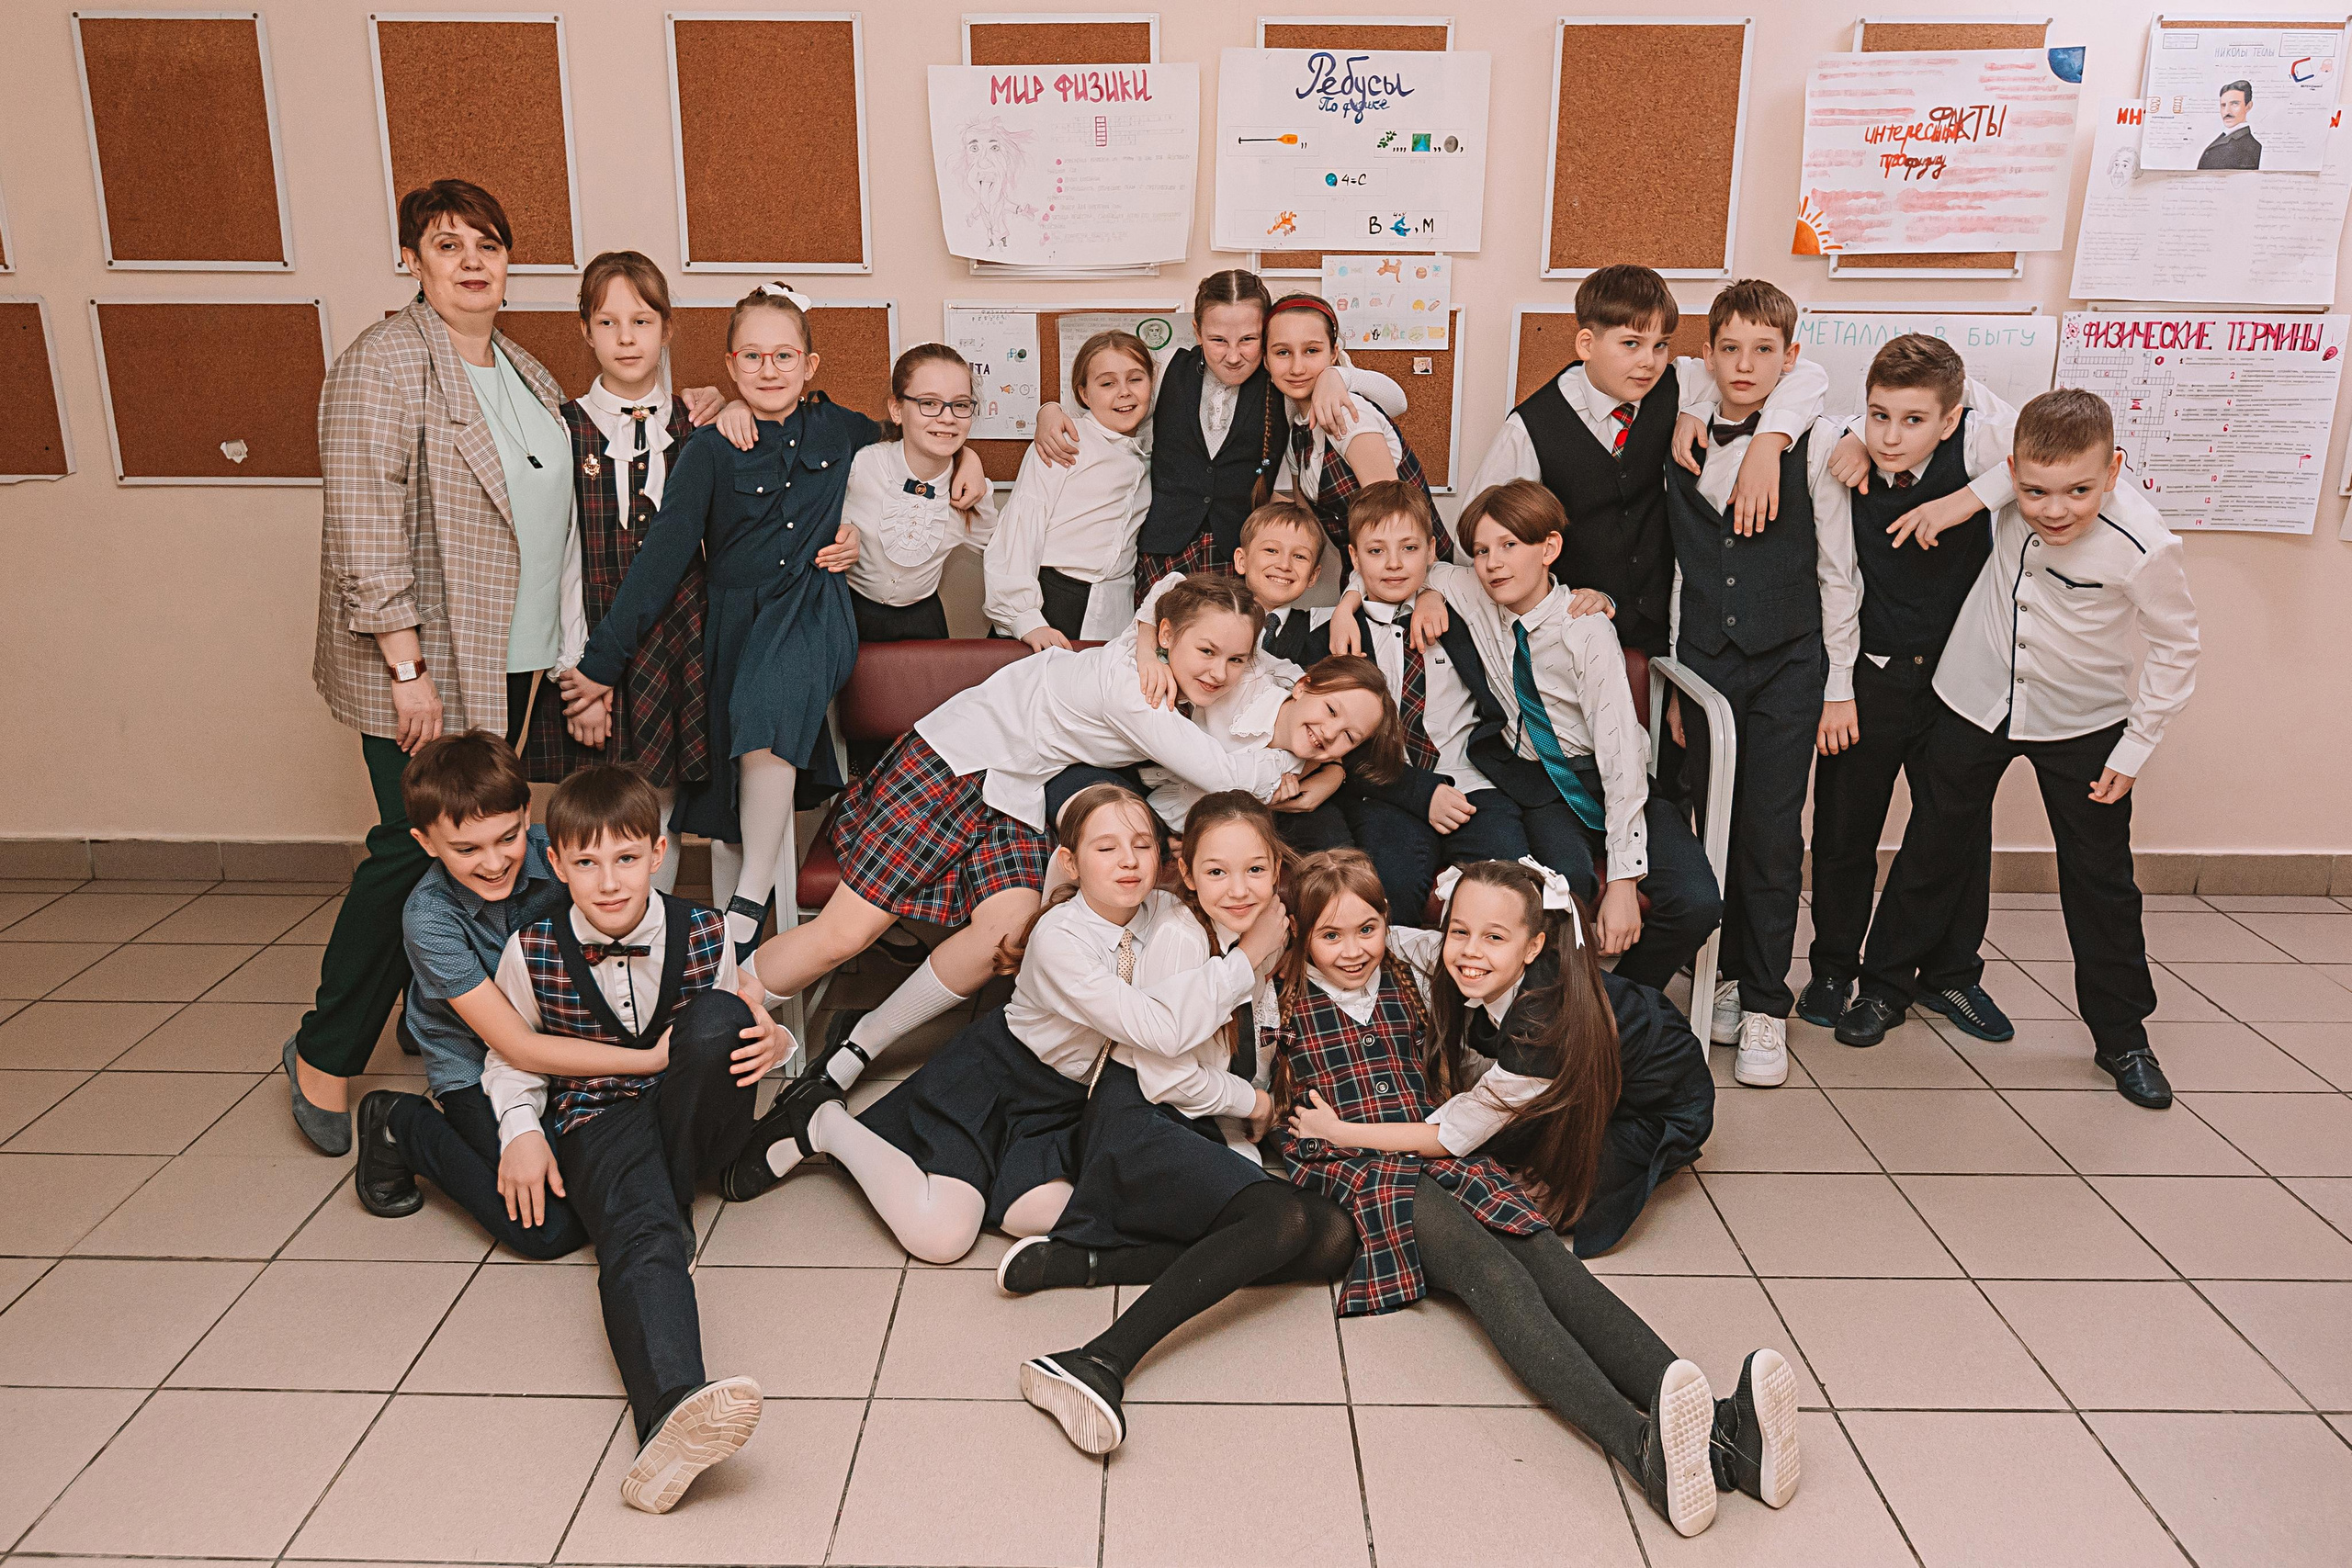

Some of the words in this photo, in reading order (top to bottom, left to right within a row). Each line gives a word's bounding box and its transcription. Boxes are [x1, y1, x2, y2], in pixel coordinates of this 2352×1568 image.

[2214, 47, 2248, 58] НИКОЛЫ
[2253, 47, 2276, 57] ТЕСЛЫ
[990, 74, 1045, 105] МИР
[1053, 69, 1153, 103] ФИЗИКИ
[1295, 51, 1415, 124] Ребусы
[2116, 107, 2145, 126] ИН
[1968, 327, 2036, 347] БЫТУ
[2083, 321, 2215, 349] ФИЗИЧЕСКИЕ
[2227, 321, 2324, 352] ТЕРМИНЫ
[2230, 371, 2235, 379] 2
[2223, 423, 2229, 432] 6
